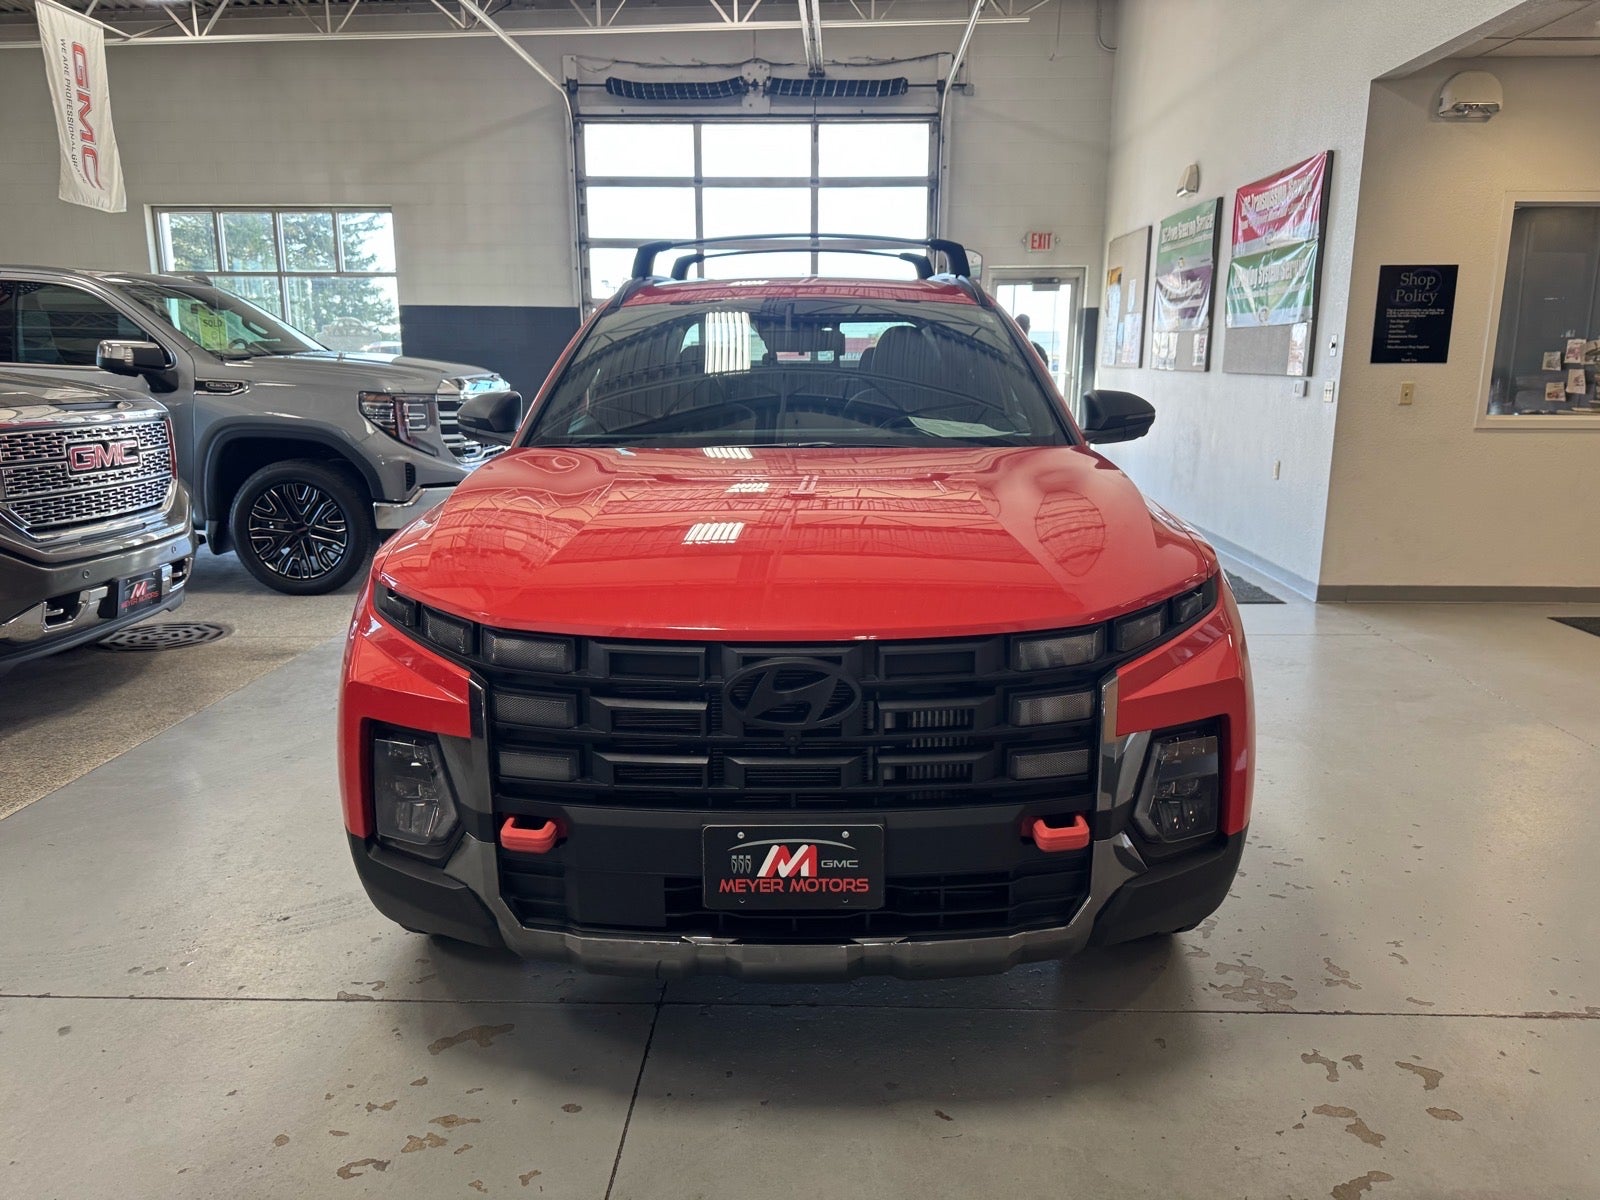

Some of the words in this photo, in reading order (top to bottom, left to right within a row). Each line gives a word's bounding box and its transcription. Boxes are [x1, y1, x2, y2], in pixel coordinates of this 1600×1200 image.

[60, 38, 67, 54] WE
[64, 78, 76, 152] PROFESSIONAL
[71, 41, 105, 191] GMC
[1031, 232, 1052, 250] EXIT
[1400, 272, 1436, 290] Shop
[1395, 289, 1438, 306] Policy
[203, 319, 223, 328] SOLD
[69, 440, 139, 471] GMC
[820, 859, 859, 868] GMC
[719, 878, 785, 893] MEYER
[789, 878, 869, 893] MOTORS
